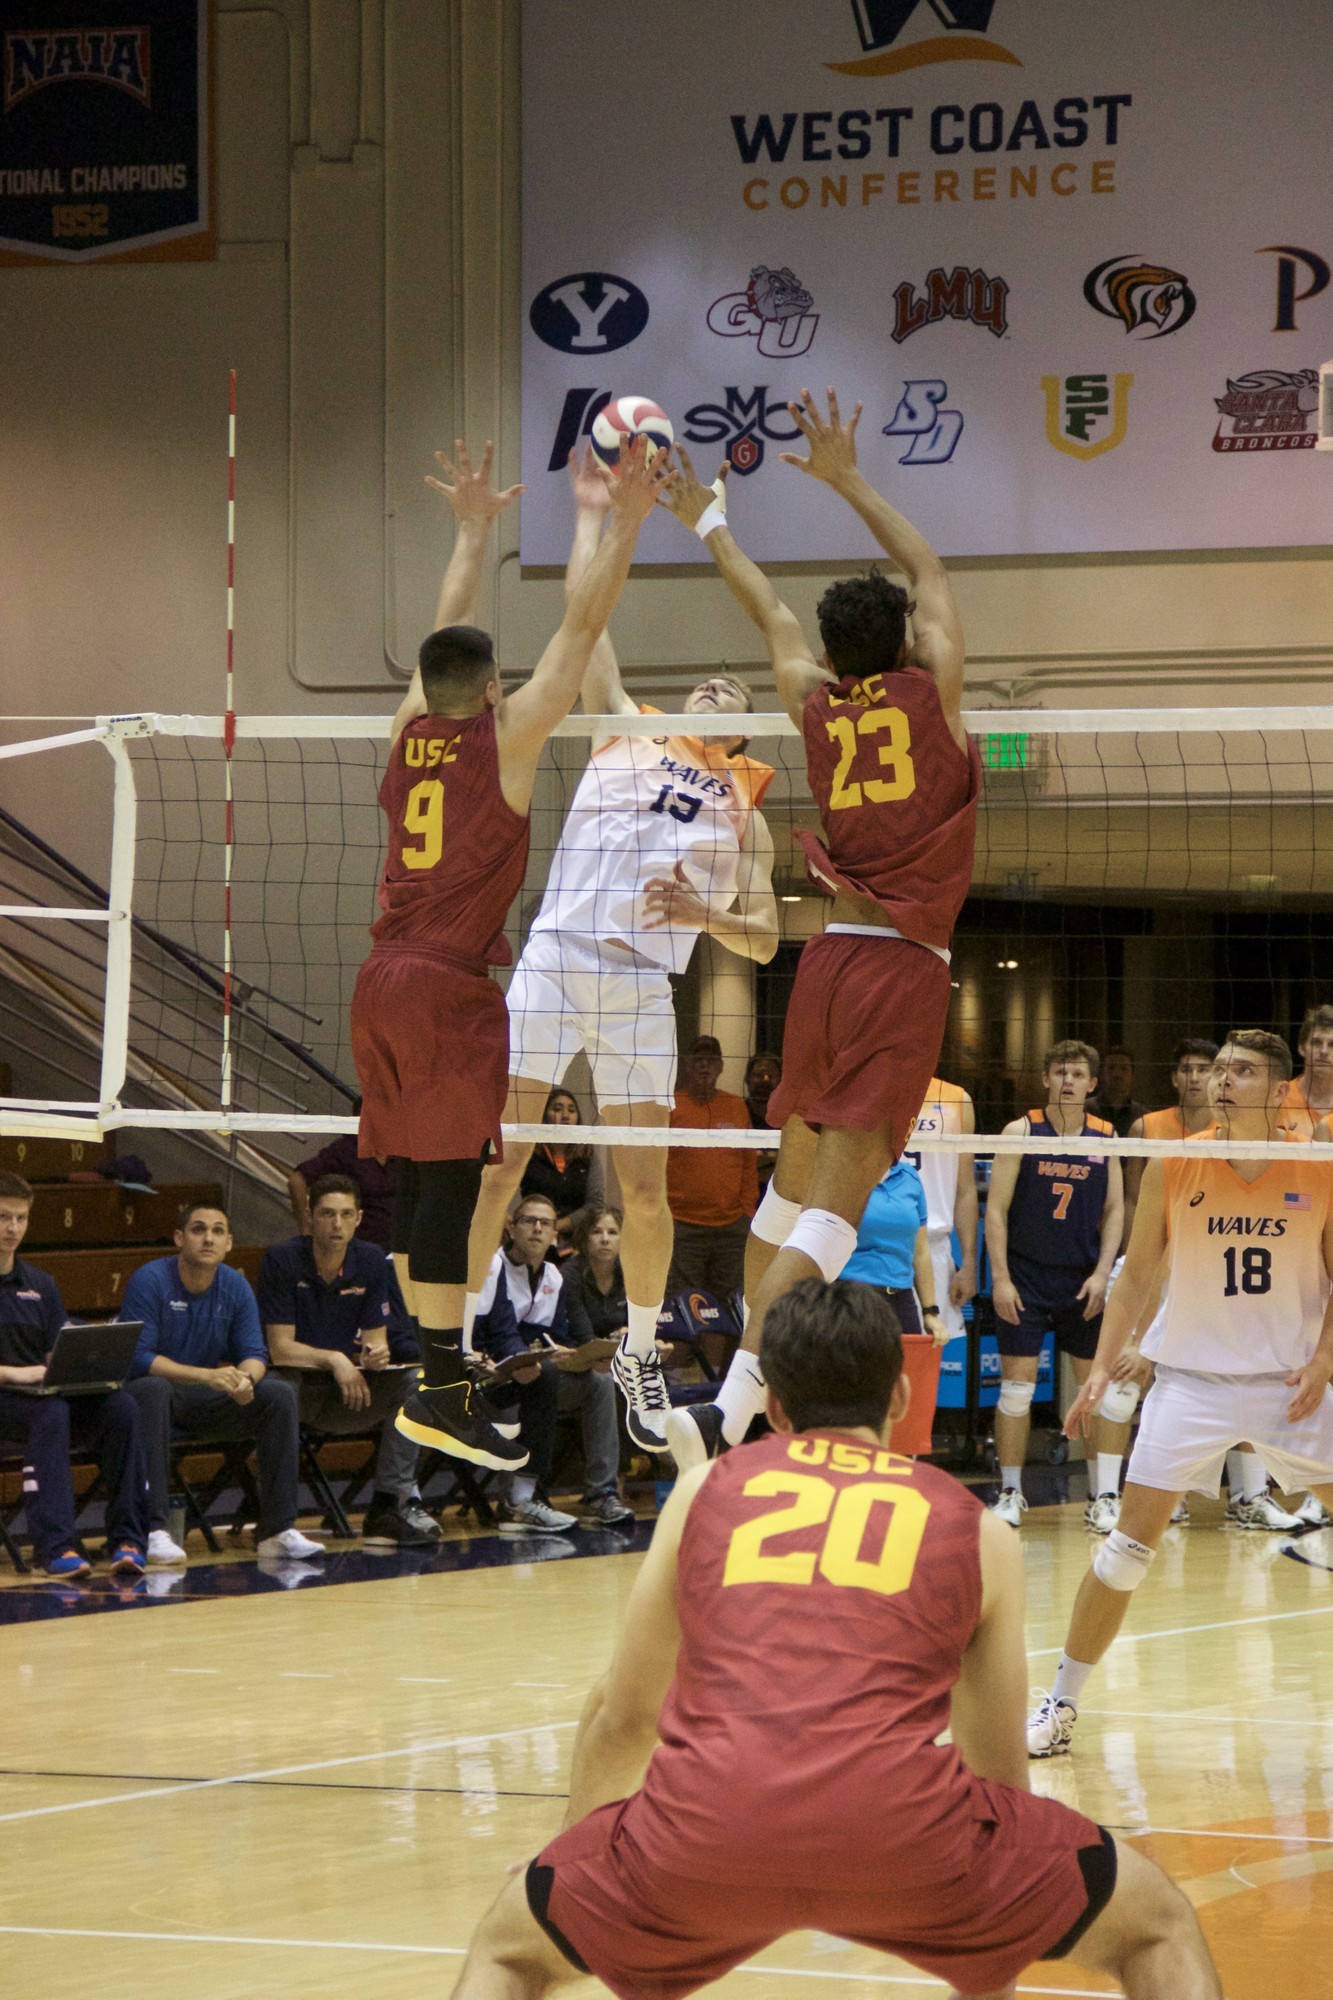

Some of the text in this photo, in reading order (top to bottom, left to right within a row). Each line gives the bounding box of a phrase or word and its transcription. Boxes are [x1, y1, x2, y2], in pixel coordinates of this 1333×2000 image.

[7, 30, 149, 101] NAIA
[730, 93, 1133, 164] WEST COAST
[71, 163, 187, 193] CHAMPIONS
[742, 159, 1117, 211] CONFERENCE
[51, 204, 110, 238] 1952
[890, 266, 1010, 344] LMU
[1220, 435, 1315, 450] BRONCOS
[825, 706, 916, 811] 23
[986, 732, 1030, 768] EXIT
[401, 778, 445, 870] 9
[1037, 1160, 1092, 1181] WAVES
[1052, 1182, 1074, 1220] 7
[1207, 1216, 1288, 1237] WAVES
[1223, 1246, 1272, 1297] 18
[786, 1438, 918, 1476] USC
[722, 1469, 932, 1596] 20
